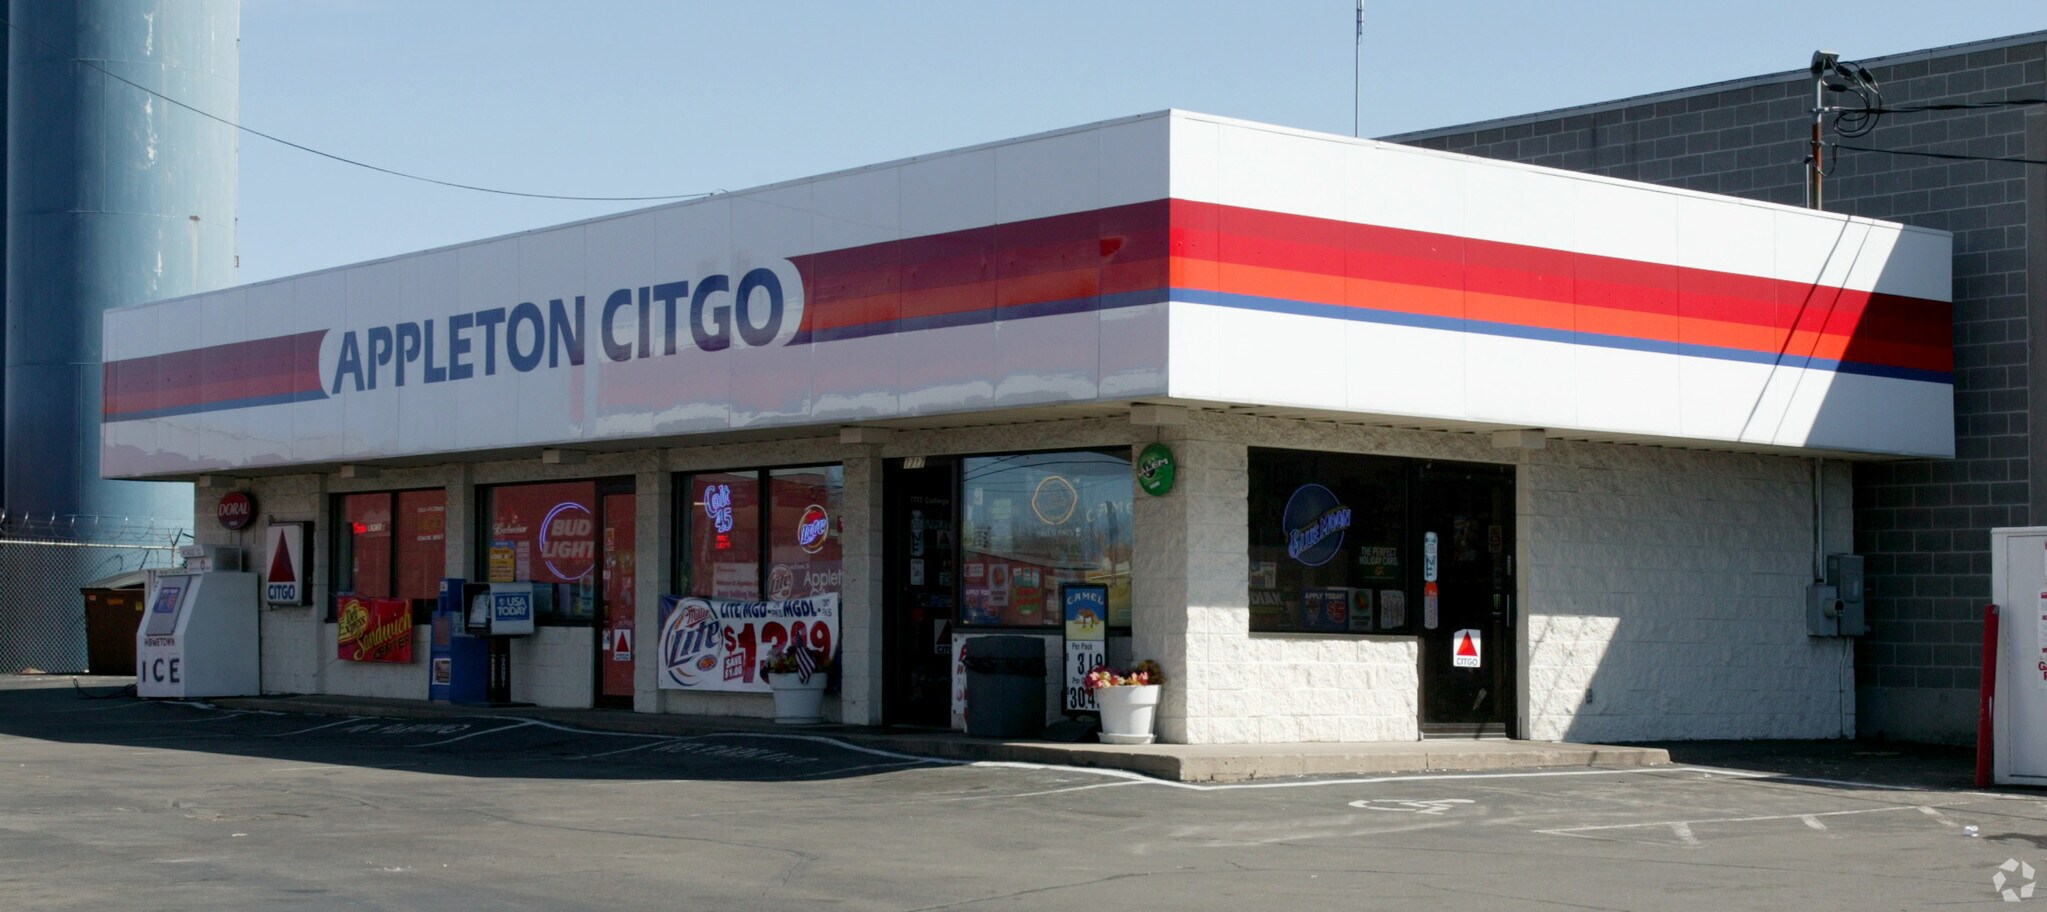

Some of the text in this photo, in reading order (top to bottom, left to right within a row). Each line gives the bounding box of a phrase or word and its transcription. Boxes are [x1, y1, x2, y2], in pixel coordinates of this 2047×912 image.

[331, 268, 784, 394] APPLETON CITGO
[219, 502, 249, 516] DORAL
[551, 519, 592, 536] BUD
[715, 507, 733, 533] 45
[542, 541, 595, 558] LIGHT
[1361, 546, 1397, 557] THE PERFECT
[268, 584, 296, 600] CITGO
[1067, 592, 1104, 605] CAMEL
[1305, 592, 1323, 600] APPLY
[507, 597, 526, 606] USA
[783, 600, 817, 617] MGDL
[497, 606, 528, 616] TODAY
[353, 599, 411, 661] Sandwich
[144, 638, 175, 647] HOMETOWN
[667, 620, 720, 669] Lite
[1081, 642, 1092, 650] Pack
[726, 656, 742, 667] SAVE
[1456, 657, 1478, 666] CITGO
[142, 658, 181, 683] ICE
[1070, 687, 1099, 709] 30.4
